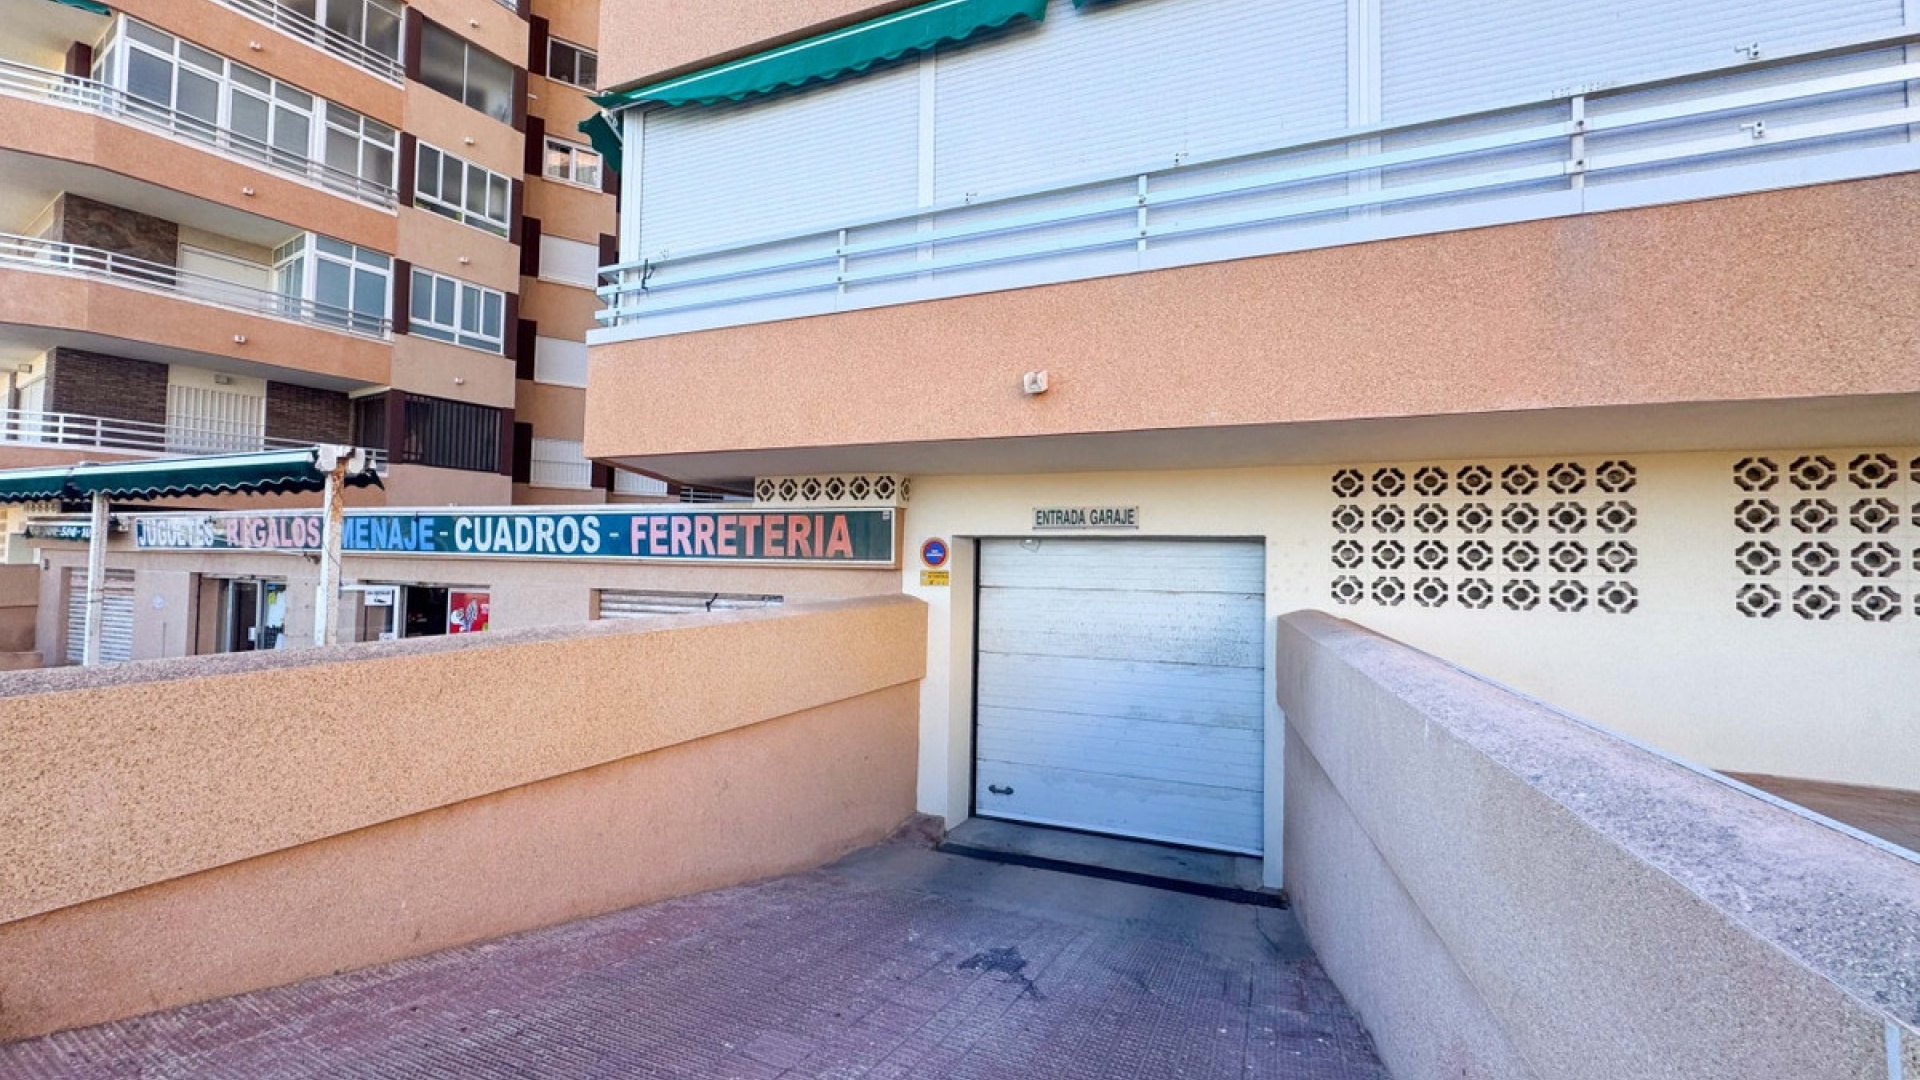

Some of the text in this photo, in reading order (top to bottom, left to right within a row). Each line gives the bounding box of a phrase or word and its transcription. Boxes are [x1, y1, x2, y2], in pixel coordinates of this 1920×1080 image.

[1036, 508, 1135, 525] ENTRADA GARAJE
[138, 518, 214, 547] JUGUETES
[226, 516, 321, 548] REGALOS
[342, 516, 435, 550] MENAJE
[454, 516, 600, 553] CUADROS
[630, 515, 854, 558] FERRETERIA
